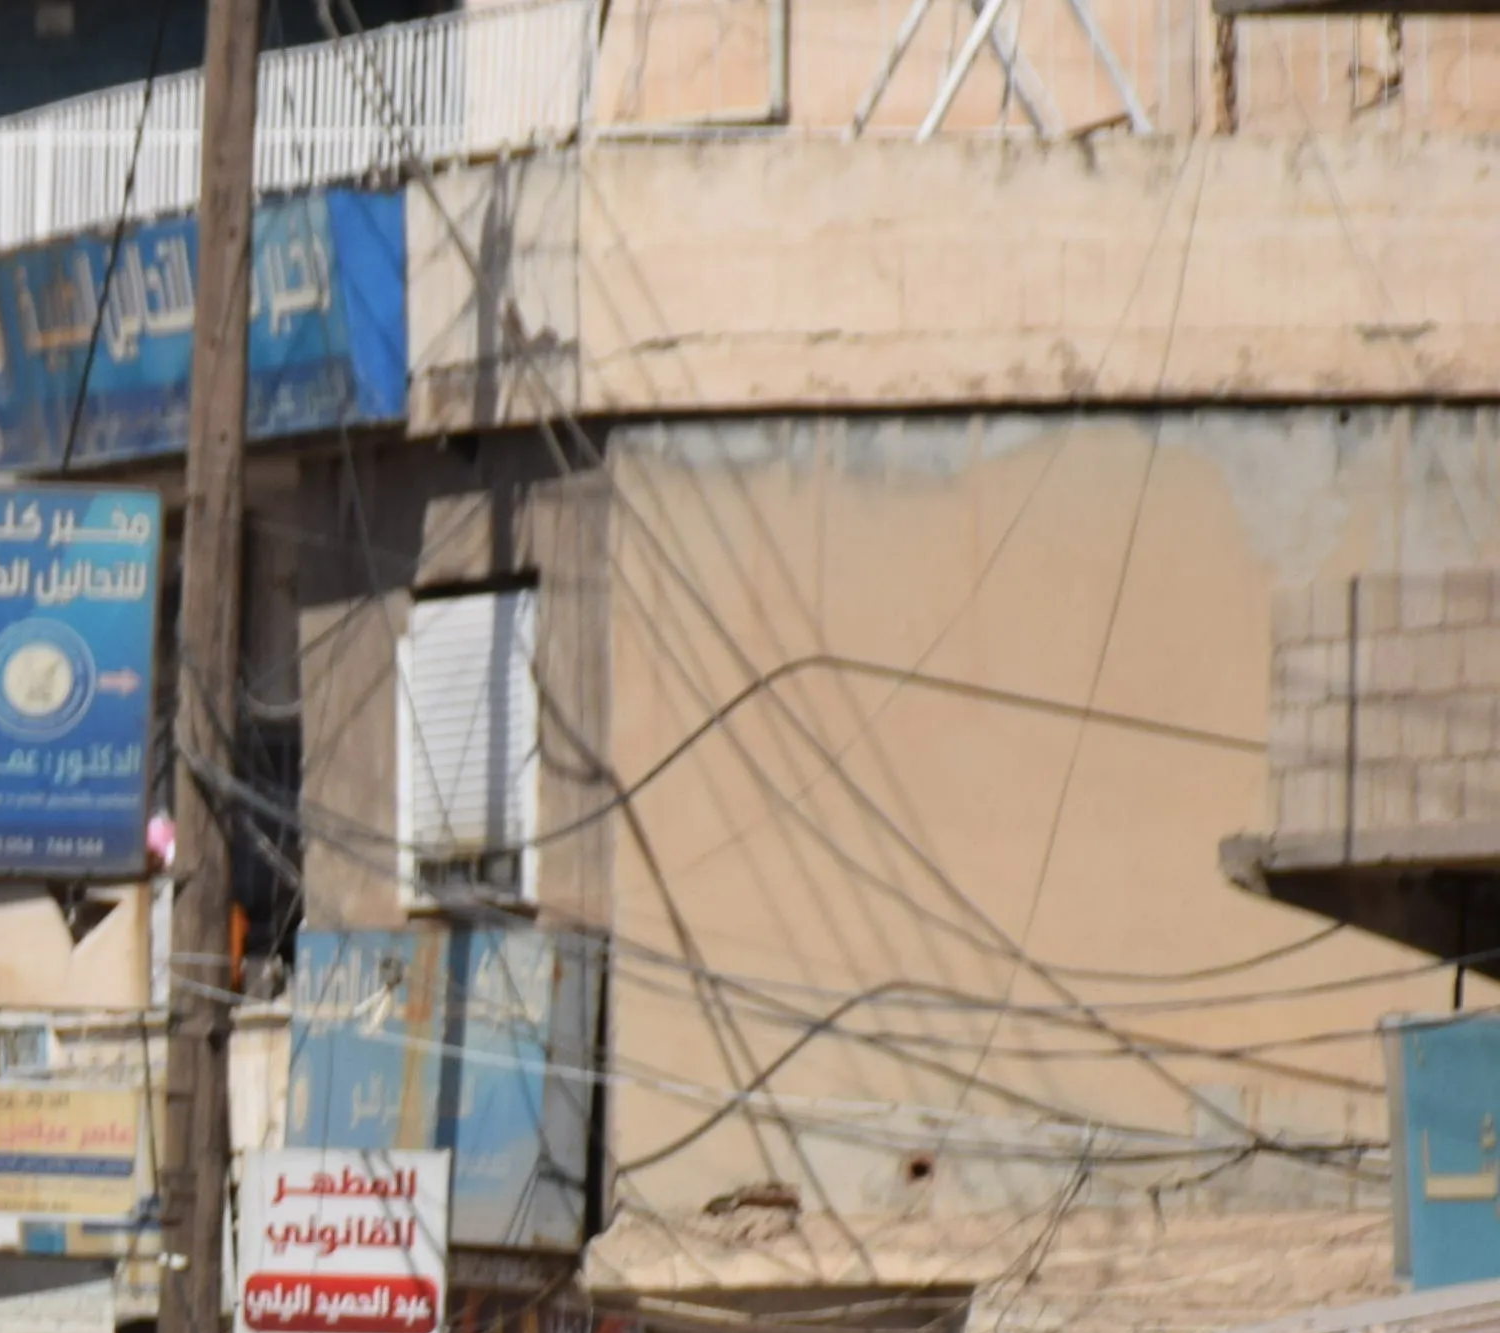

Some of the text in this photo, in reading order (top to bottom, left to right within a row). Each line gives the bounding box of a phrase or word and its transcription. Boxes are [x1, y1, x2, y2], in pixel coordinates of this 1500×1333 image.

[48, 504, 150, 548] مخبر
[35, 559, 147, 607] للتحاليل
[272, 1165, 417, 1207] المطهر
[266, 1213, 416, 1257] القانوني
[314, 1285, 390, 1325] الحميد
[393, 1293, 433, 1326] عبد
